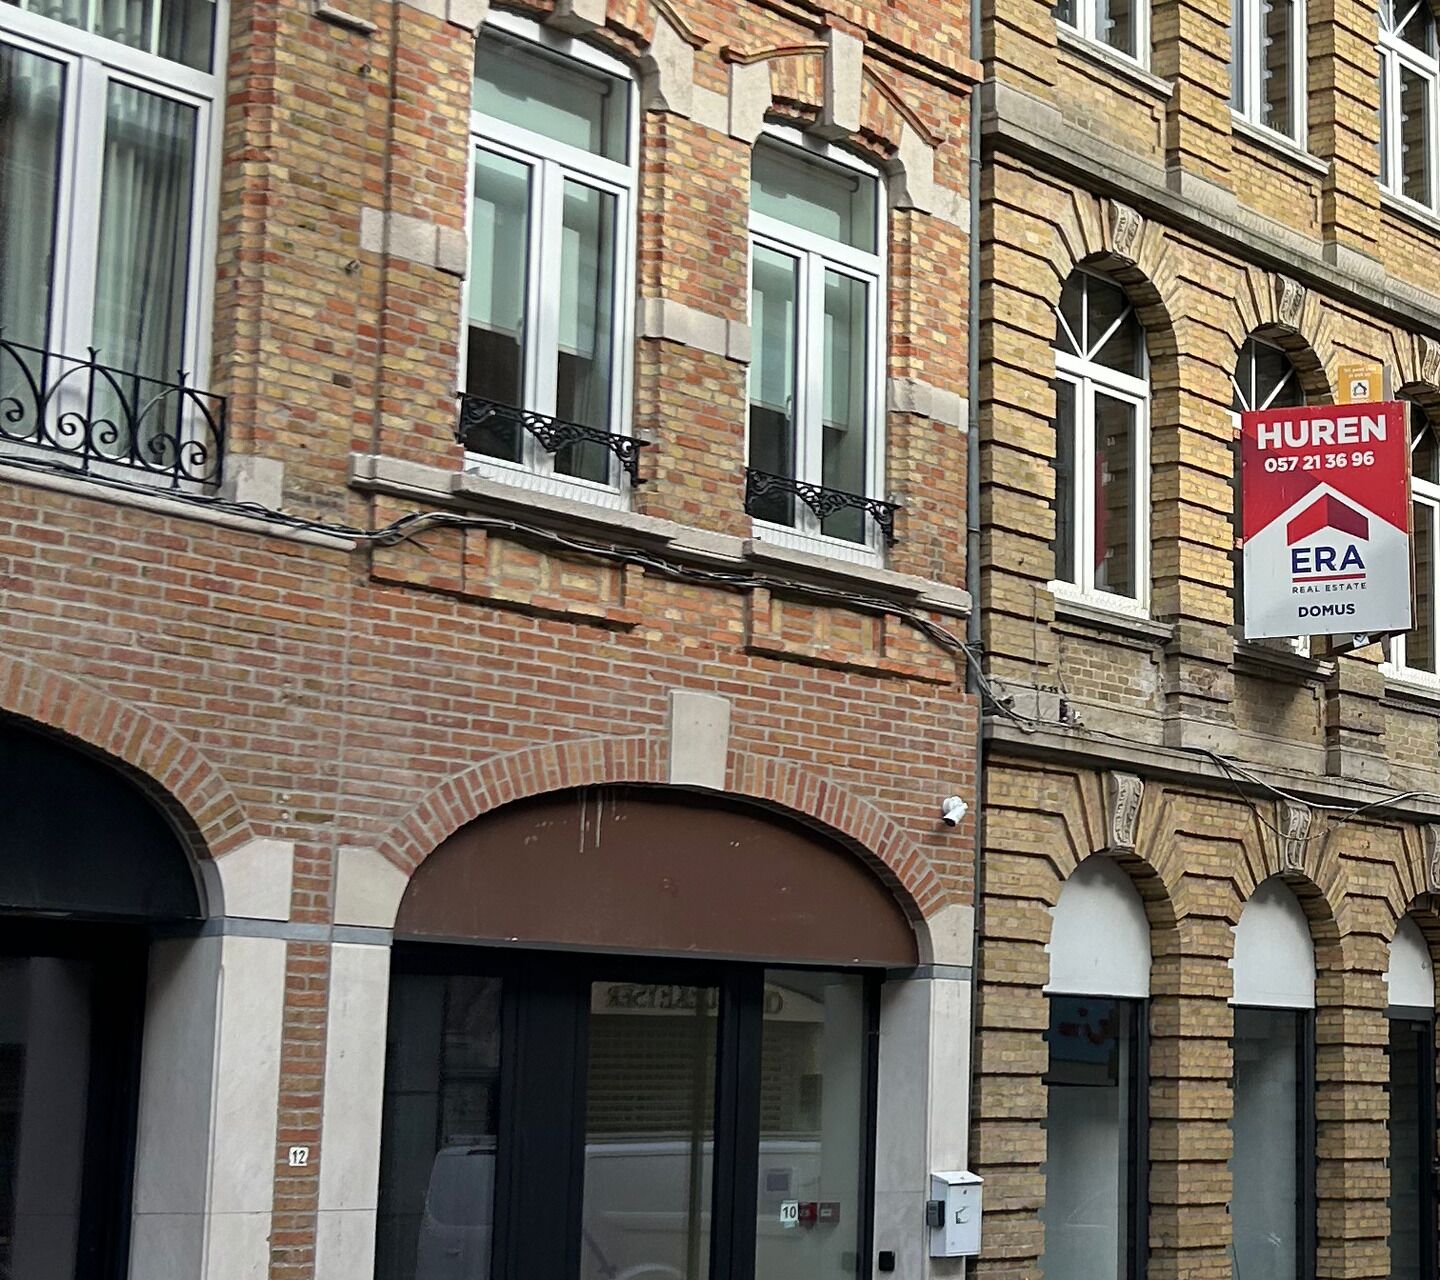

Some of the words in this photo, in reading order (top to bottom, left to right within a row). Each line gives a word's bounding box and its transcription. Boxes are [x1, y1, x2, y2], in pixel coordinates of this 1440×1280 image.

[1257, 414, 1387, 450] HUREN
[1264, 456, 1299, 473] 057
[1302, 454, 1321, 470] 21
[1325, 452, 1348, 469] 36
[1351, 450, 1375, 467] 96
[1291, 544, 1366, 574] ERA
[1292, 585, 1320, 594] REAL
[1325, 581, 1367, 592] ESTATE
[1298, 603, 1356, 618] DOMUS
[293, 1150, 306, 1164] 12
[782, 1206, 796, 1218] 10
